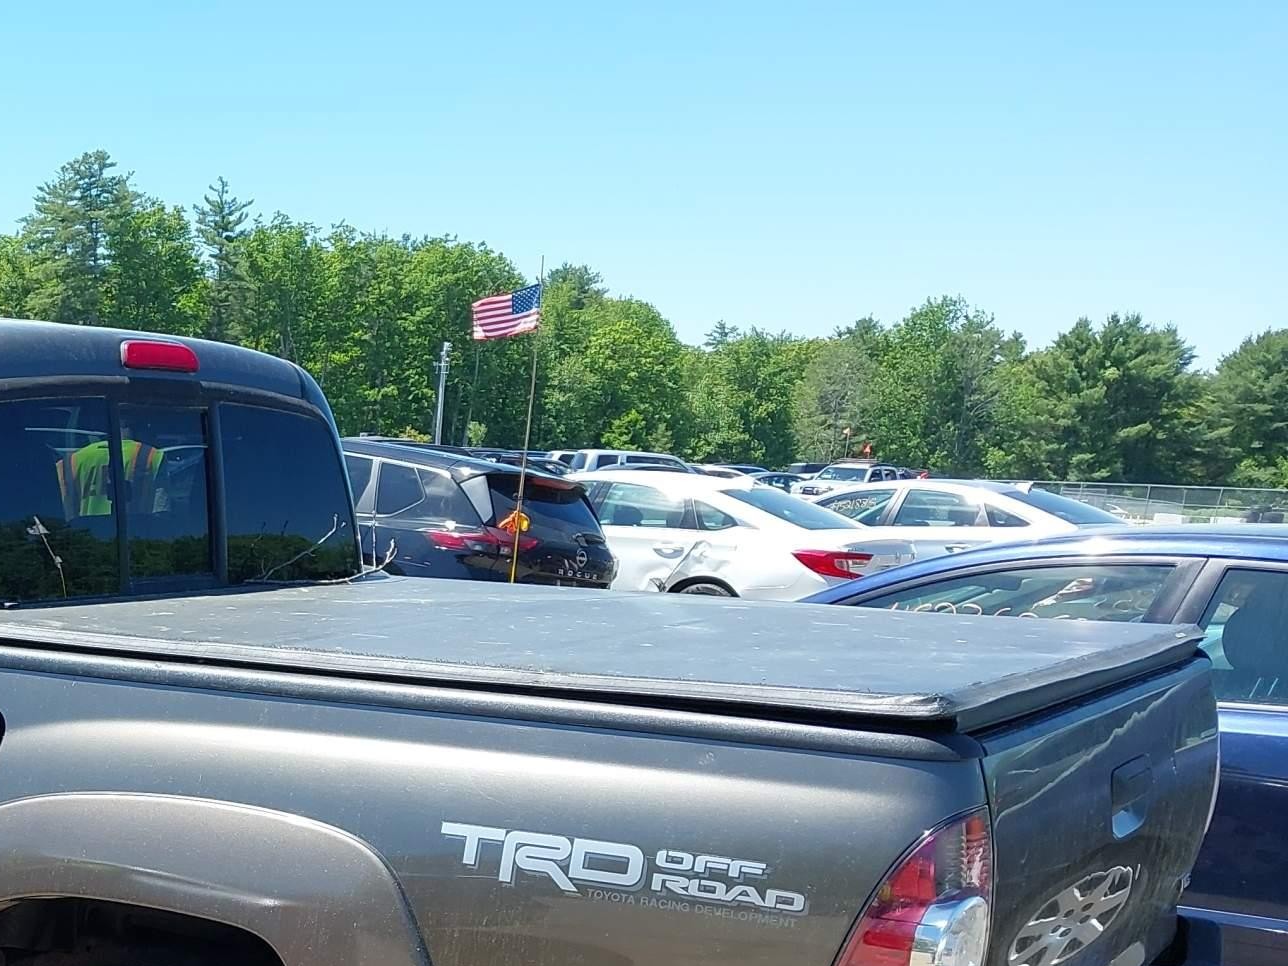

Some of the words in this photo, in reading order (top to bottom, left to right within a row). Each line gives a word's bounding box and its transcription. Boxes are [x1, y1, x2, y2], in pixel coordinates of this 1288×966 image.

[558, 568, 598, 580] ROGUE
[441, 821, 648, 896] TRD
[654, 849, 770, 881] OFF
[587, 888, 635, 906] TOYOTA
[640, 897, 690, 913] RACING
[695, 904, 798, 928] DEVELOPMENT
[650, 873, 809, 915] ROAD
